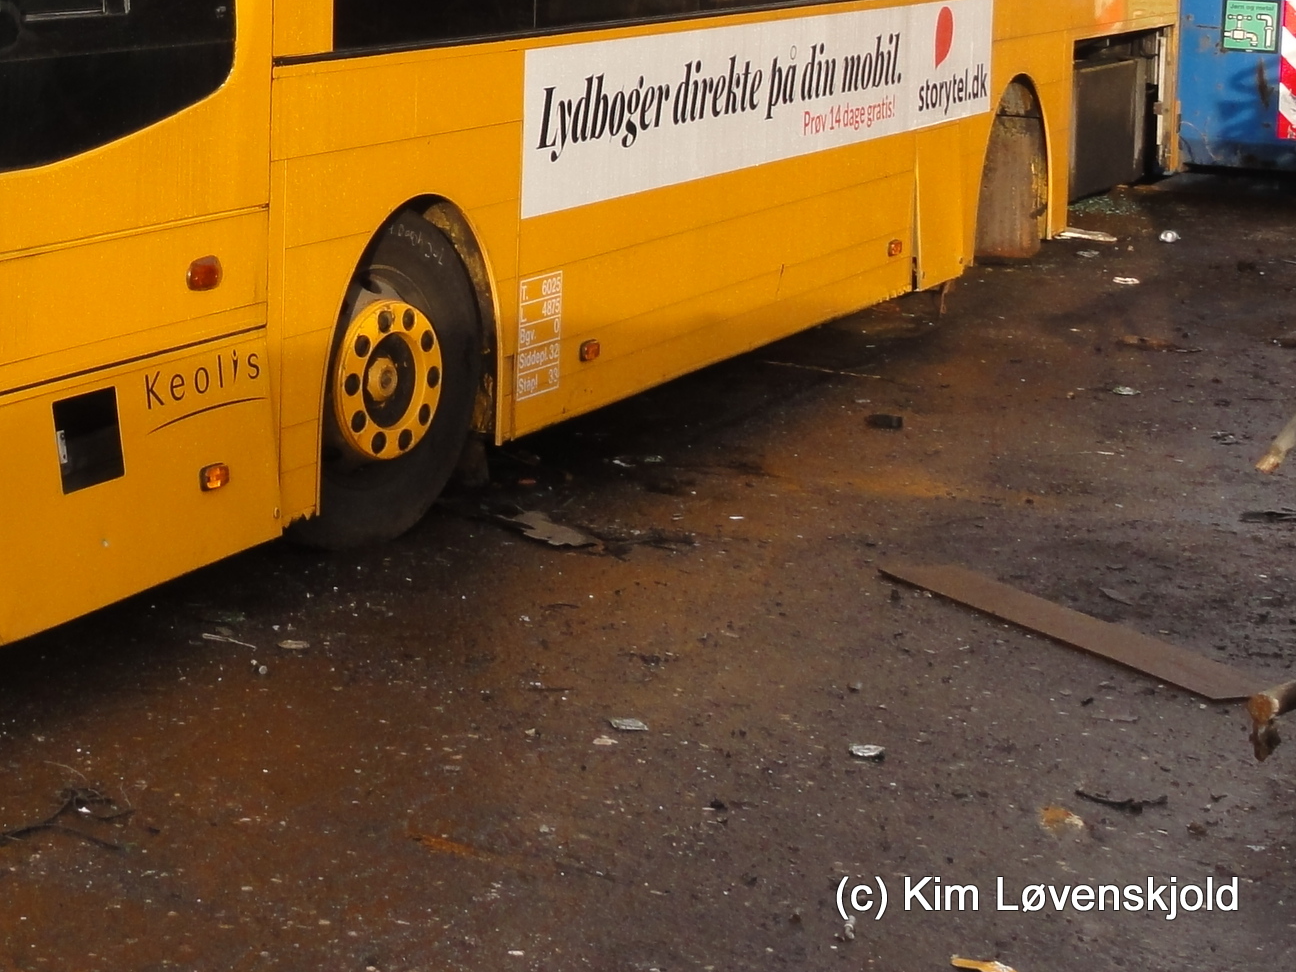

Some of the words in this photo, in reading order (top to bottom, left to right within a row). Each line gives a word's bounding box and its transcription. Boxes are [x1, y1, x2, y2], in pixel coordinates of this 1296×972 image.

[536, 73, 670, 162] Lydbøger
[673, 54, 762, 125] direkte
[765, 45, 797, 120] på
[801, 42, 836, 101] din
[841, 32, 902, 93] mobil.
[918, 63, 988, 115] storytel.dk
[804, 111, 827, 136] Prøv
[829, 104, 841, 130] 14
[843, 102, 865, 131] dage
[867, 94, 896, 128] gratis!
[542, 277, 561, 295] 6025
[542, 299, 560, 316] 4875
[144, 349, 260, 410] Keolis
